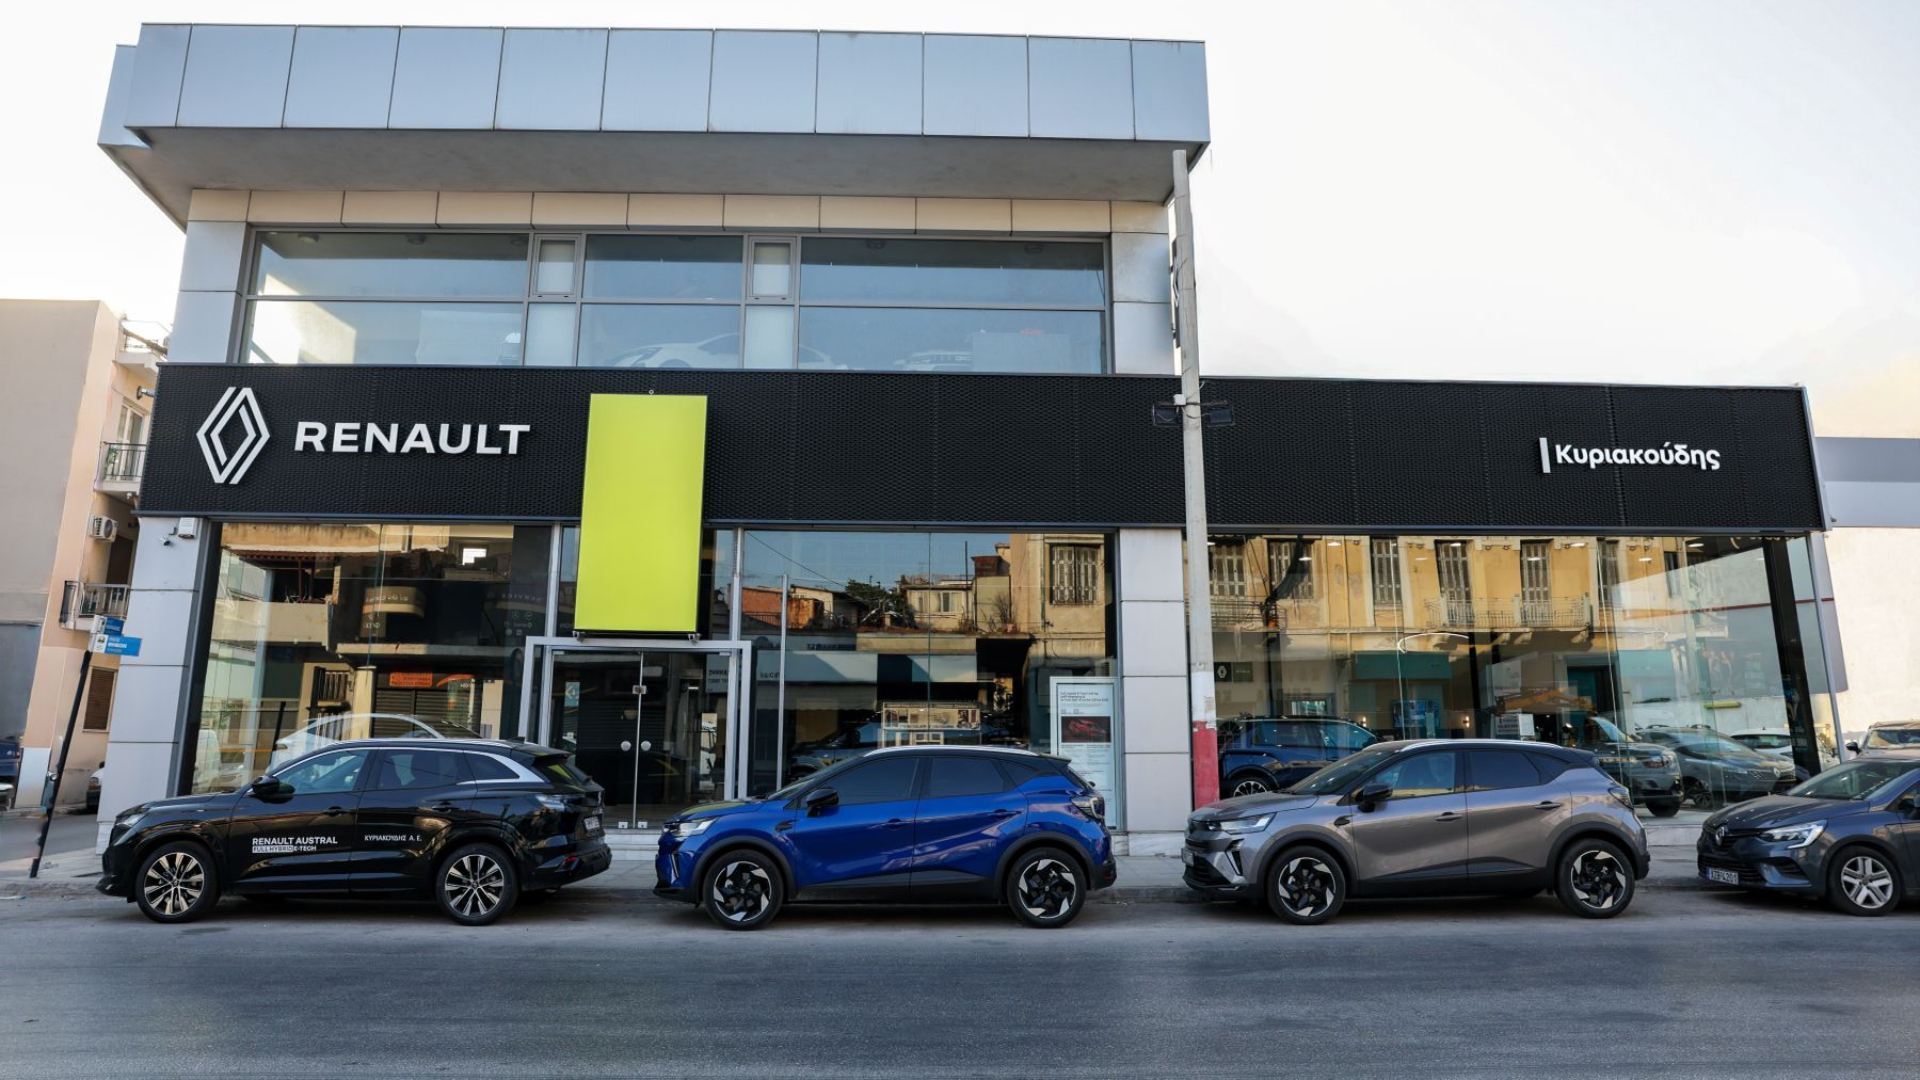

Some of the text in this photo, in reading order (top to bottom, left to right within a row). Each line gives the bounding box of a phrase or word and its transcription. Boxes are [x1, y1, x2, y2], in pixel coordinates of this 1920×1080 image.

[294, 421, 531, 455] RENAULT
[1555, 441, 1721, 471] Κυριακούδης
[252, 836, 338, 846] RENAULT AUSTRAL
[269, 845, 294, 853] HYBRID
